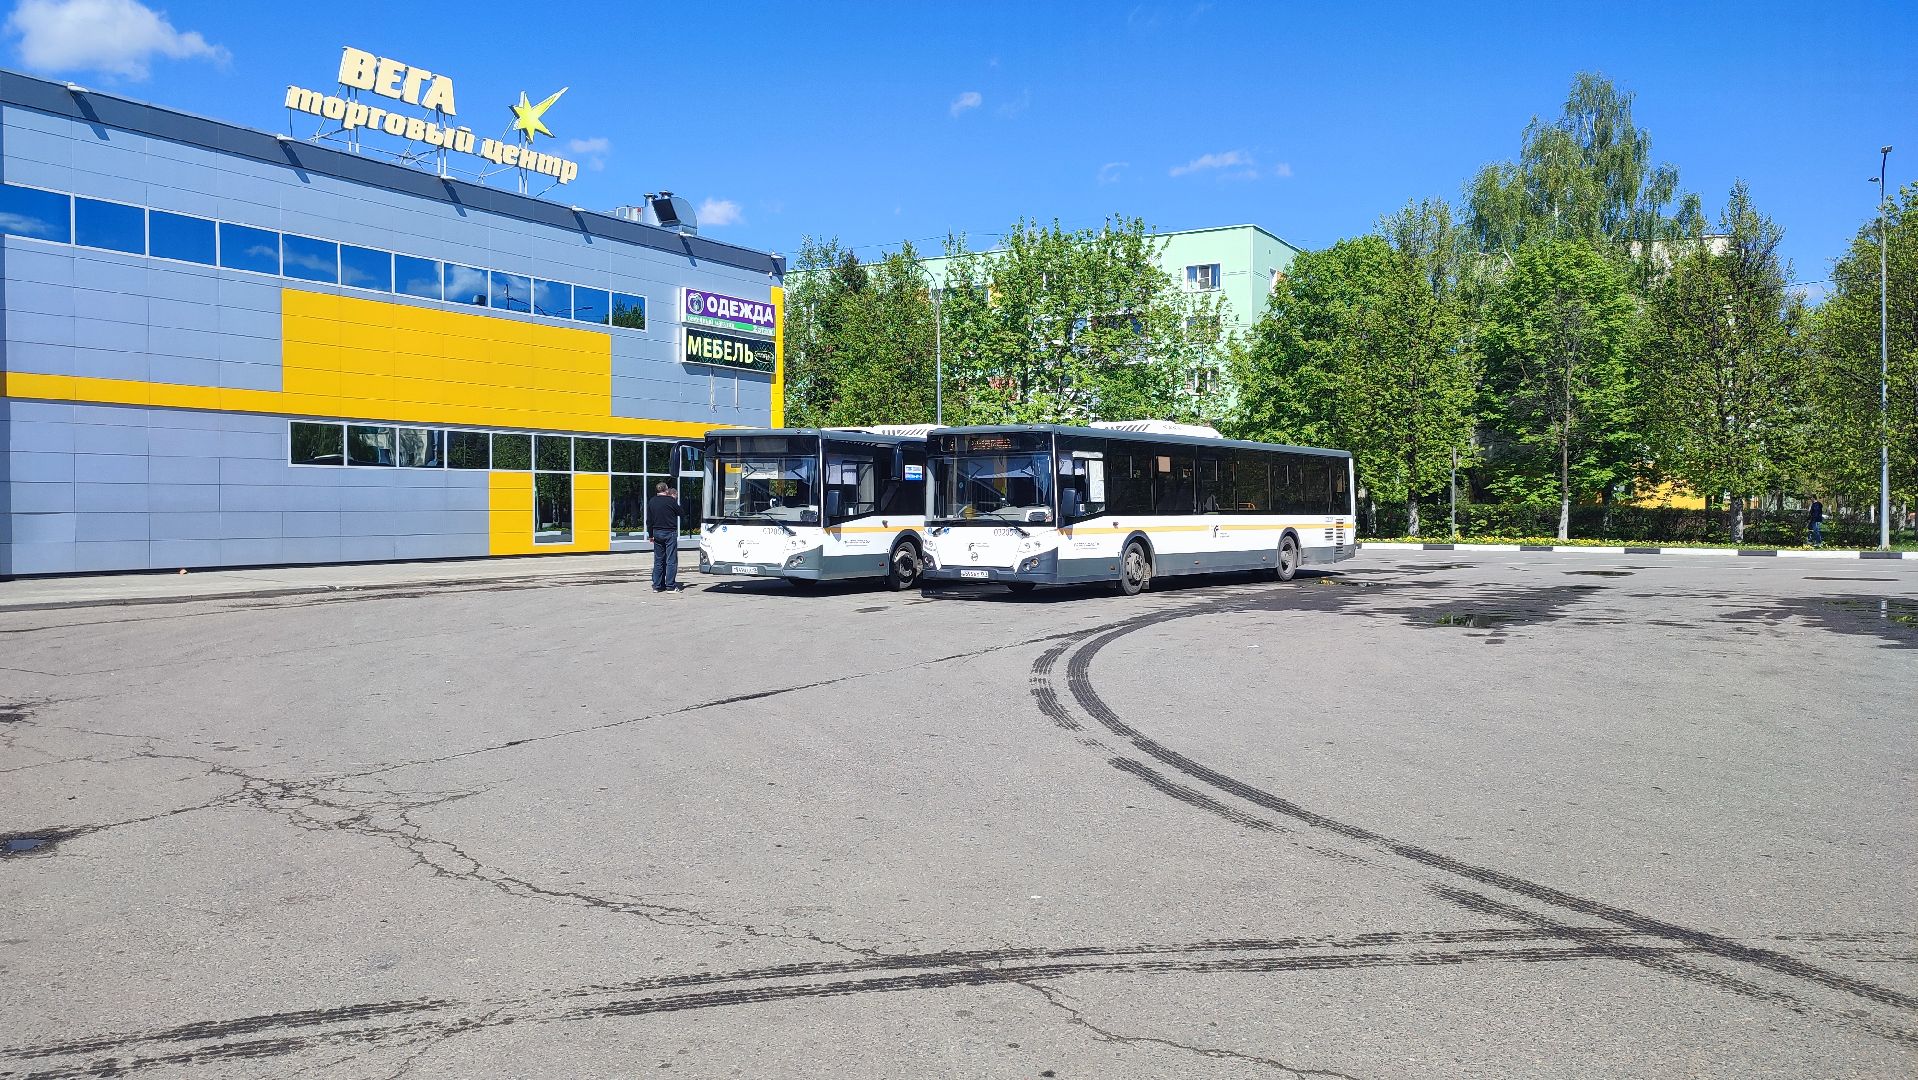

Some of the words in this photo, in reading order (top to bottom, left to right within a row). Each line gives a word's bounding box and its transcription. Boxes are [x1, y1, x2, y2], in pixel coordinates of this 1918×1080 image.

[338, 46, 457, 116] ВЕГА
[285, 85, 477, 154] торговый
[480, 137, 579, 185] центр
[706, 296, 774, 325] ОДЕЖДА
[687, 335, 753, 364] МЕБЕЛЬ
